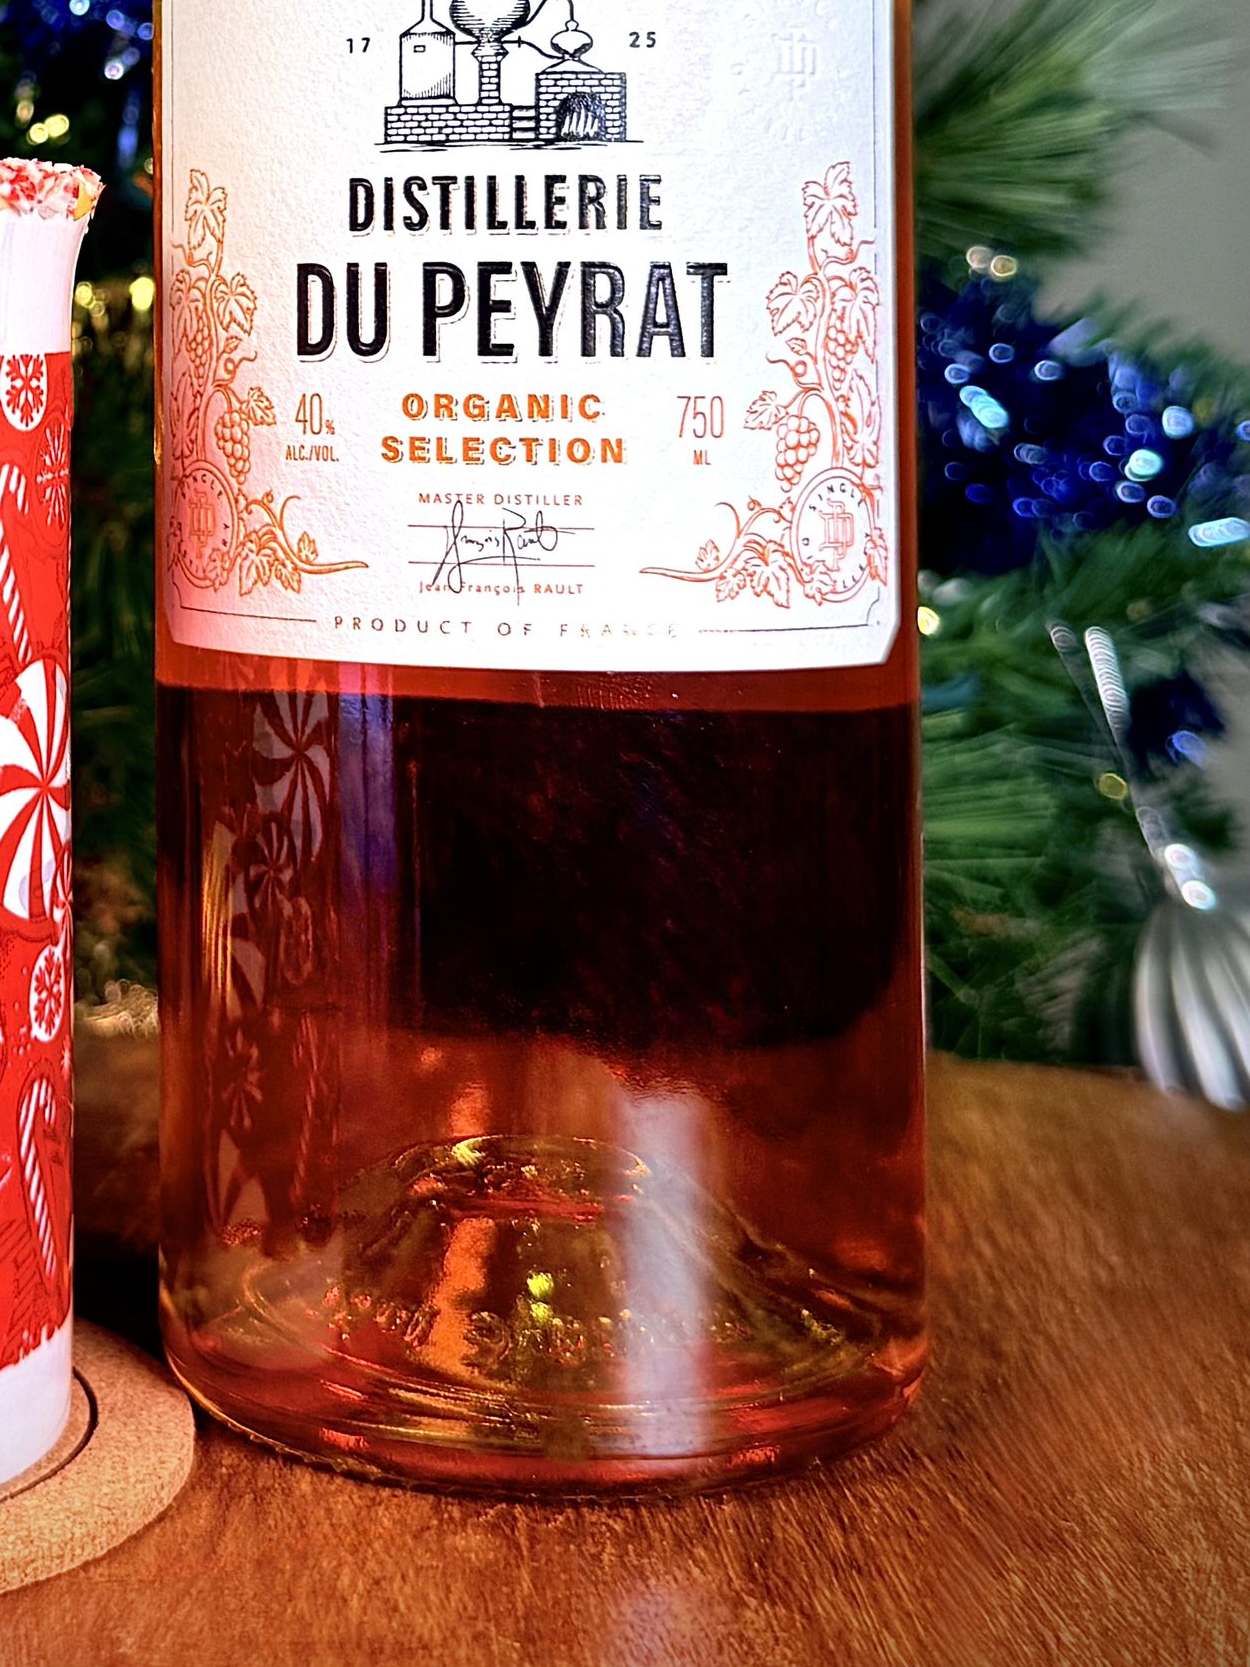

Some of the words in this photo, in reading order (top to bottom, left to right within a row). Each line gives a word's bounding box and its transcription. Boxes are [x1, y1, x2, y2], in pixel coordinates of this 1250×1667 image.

[346, 37, 371, 54] 17
[628, 31, 656, 49] 25
[348, 174, 664, 235] DISTILLERIE
[296, 261, 391, 363] DU
[421, 260, 732, 363] PEYRAT
[401, 392, 605, 422] ORGANIC
[676, 395, 725, 439] 750
[380, 435, 628, 466] SELECTION
[692, 449, 712, 466] ML
[417, 492, 485, 506] MASTER
[493, 493, 583, 506] DISTILLER
[533, 583, 584, 595] RAULT
[334, 615, 472, 635] PRODUCT
[496, 621, 533, 637] OF
